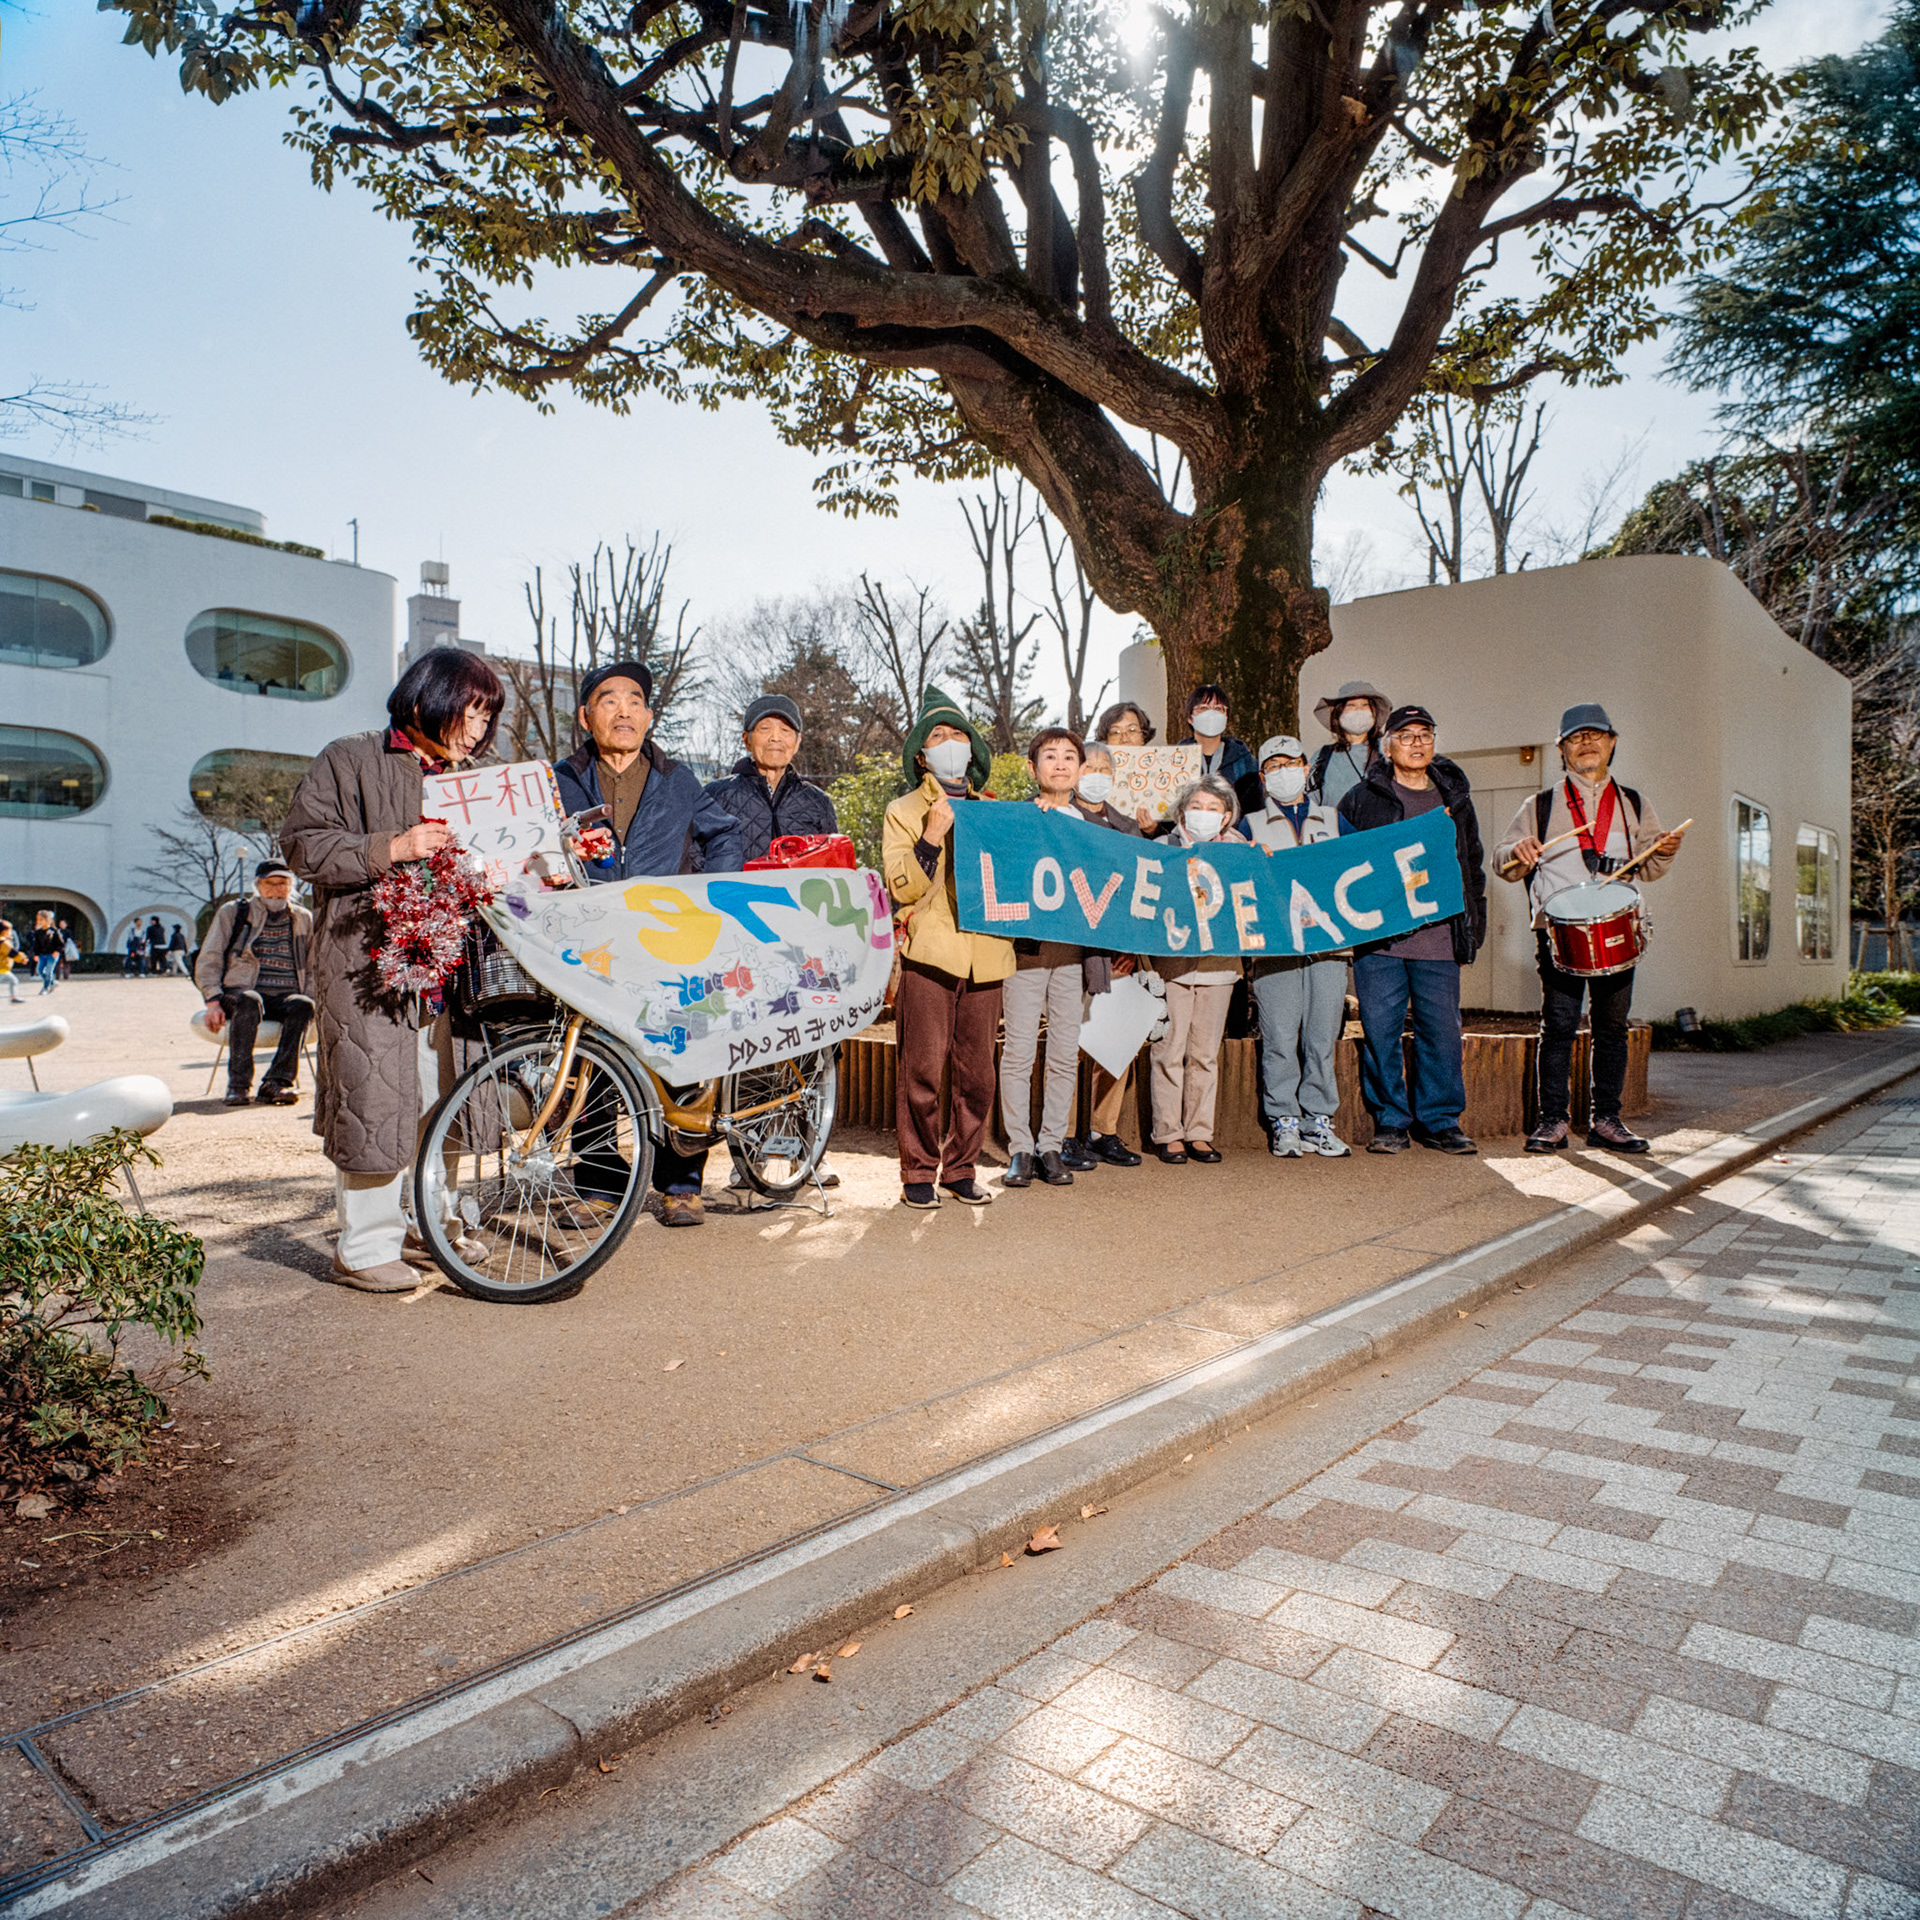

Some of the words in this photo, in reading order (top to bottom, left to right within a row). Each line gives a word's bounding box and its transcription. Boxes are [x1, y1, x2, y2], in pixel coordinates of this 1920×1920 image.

[980, 851, 1164, 929] LOVE
[1163, 907, 1191, 951] &
[1186, 842, 1439, 953] PEACE
